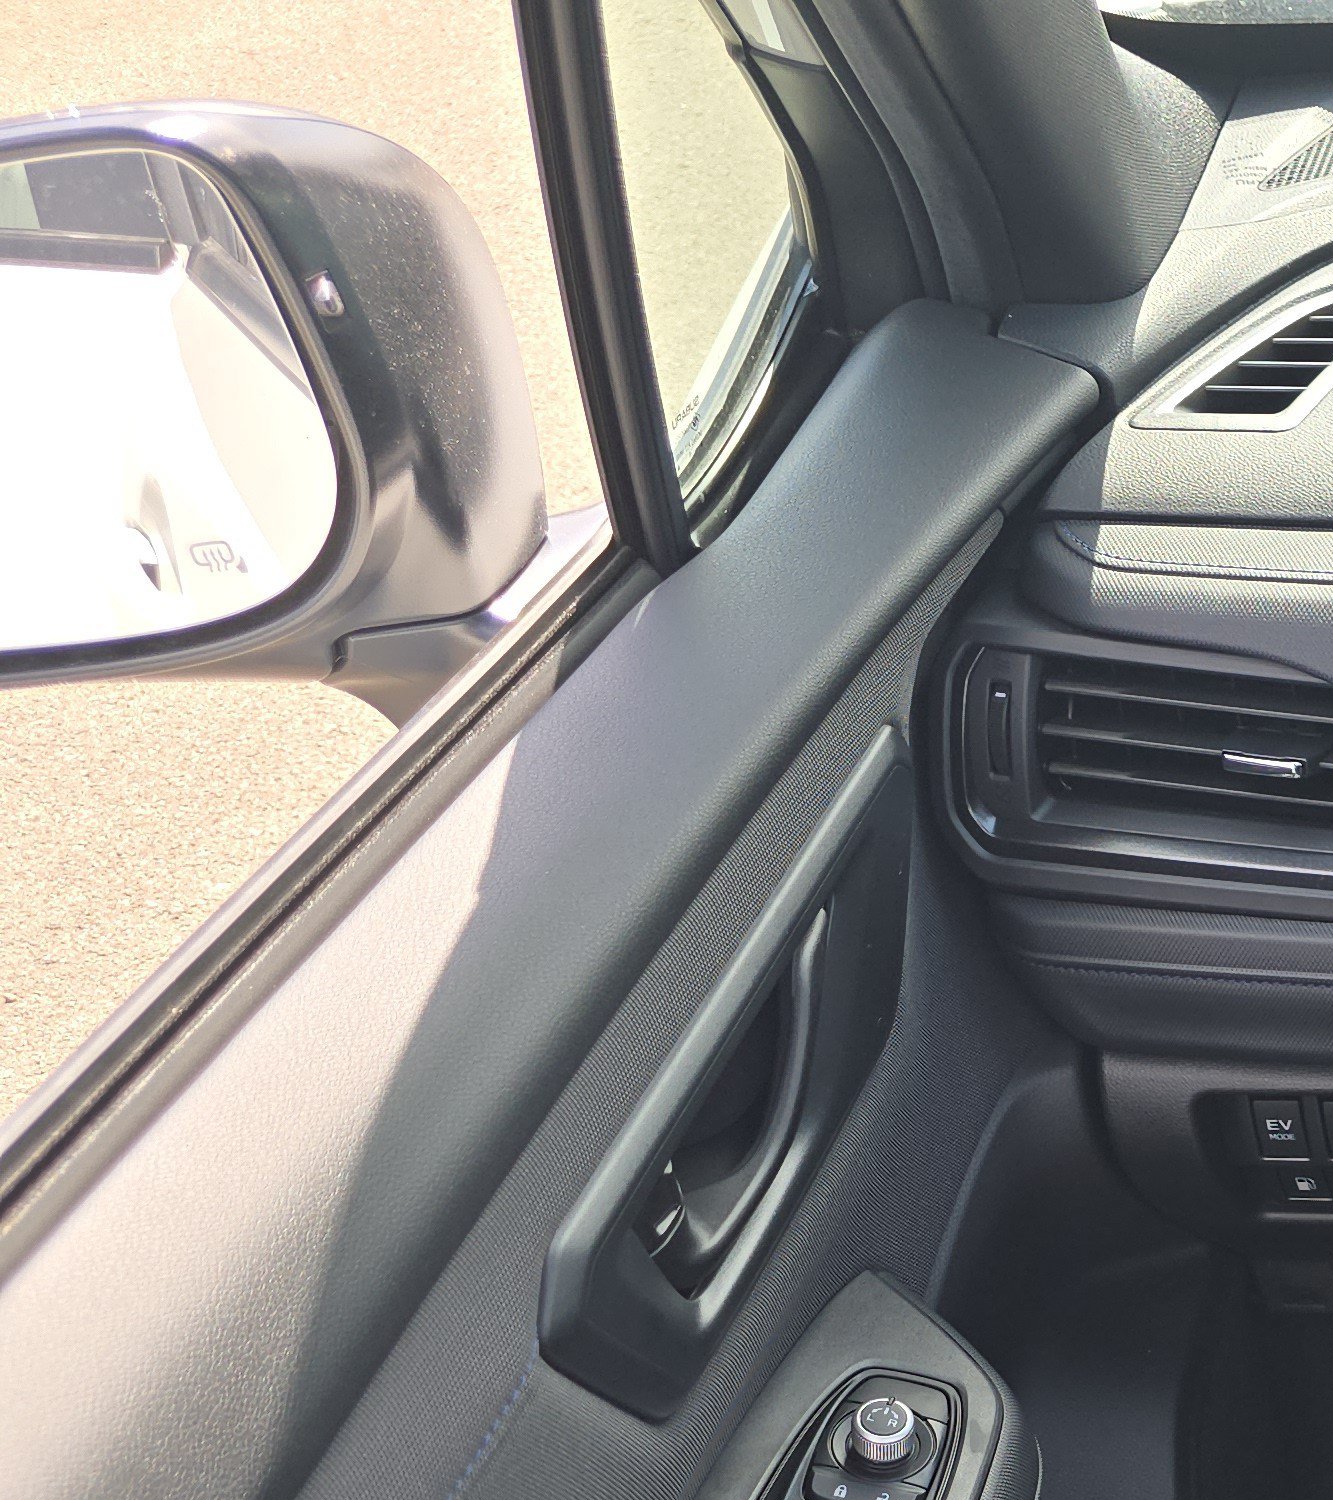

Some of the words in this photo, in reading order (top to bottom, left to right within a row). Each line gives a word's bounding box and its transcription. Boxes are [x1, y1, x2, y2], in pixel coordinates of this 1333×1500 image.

[1266, 1119, 1292, 1131] EV
[1269, 1133, 1296, 1141] MODE
[887, 1418, 898, 1428] R
